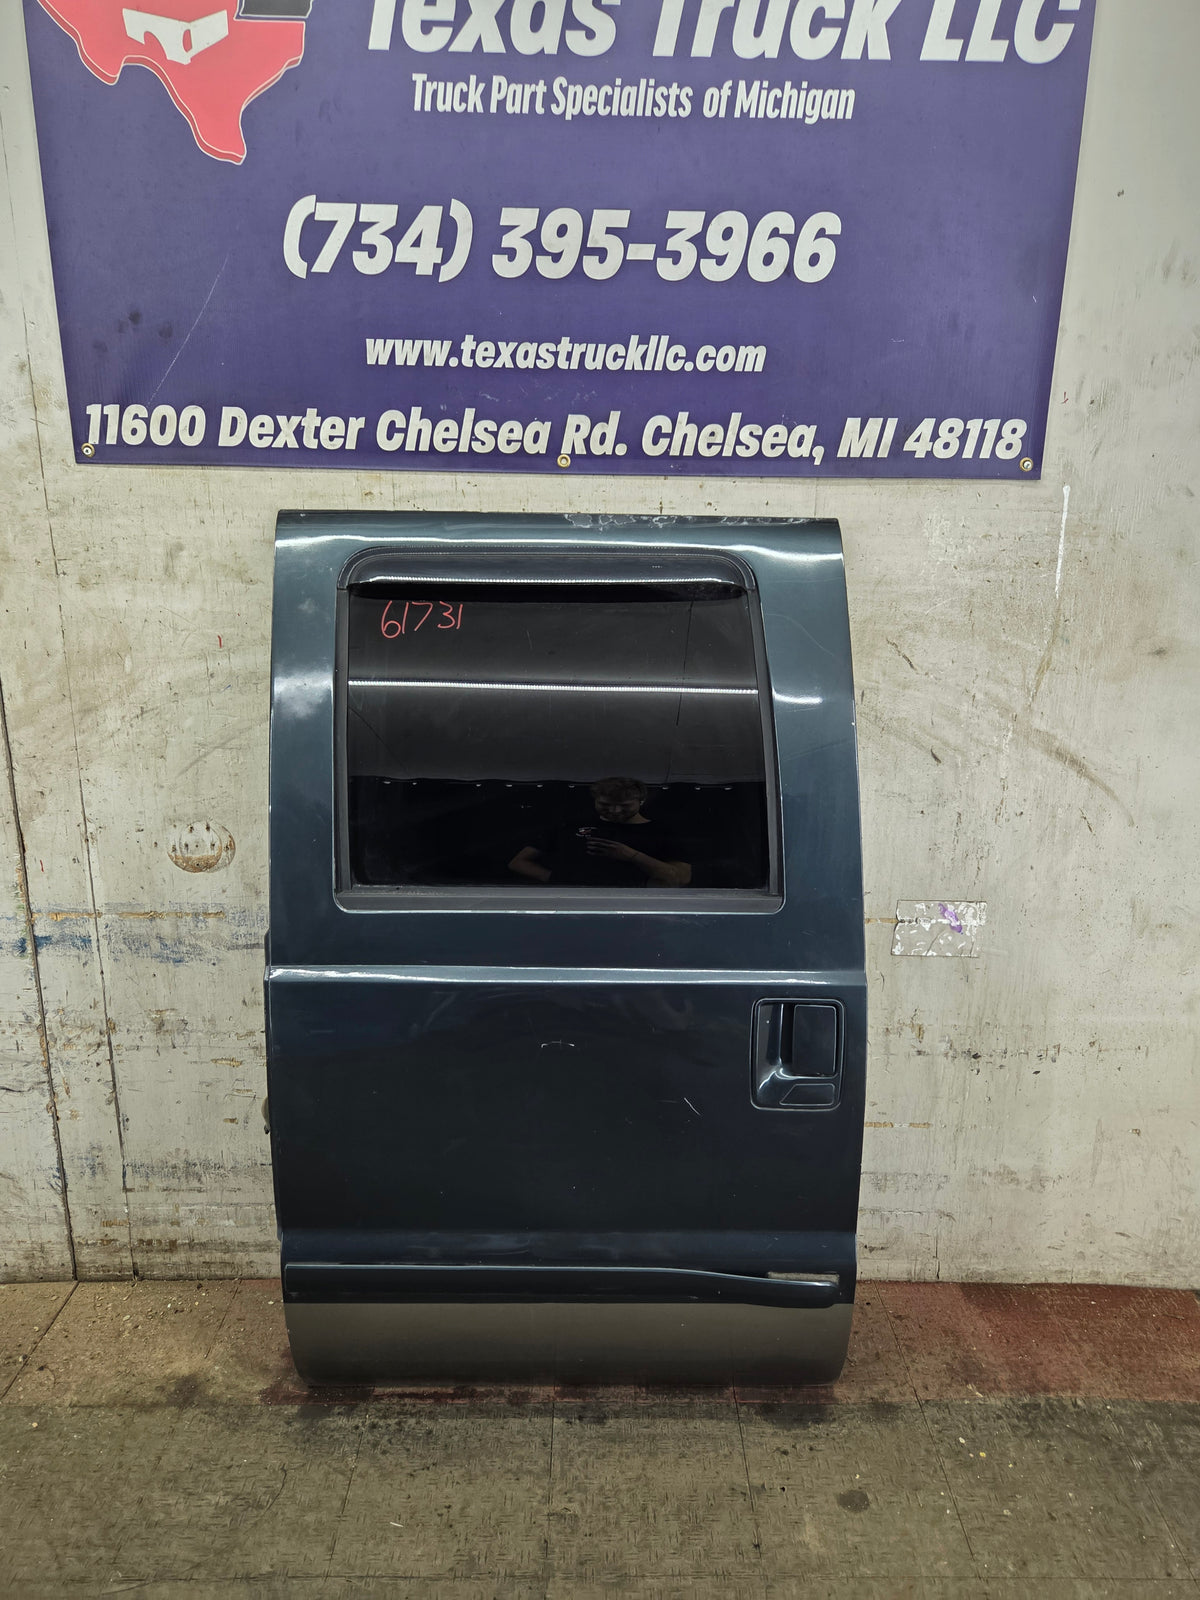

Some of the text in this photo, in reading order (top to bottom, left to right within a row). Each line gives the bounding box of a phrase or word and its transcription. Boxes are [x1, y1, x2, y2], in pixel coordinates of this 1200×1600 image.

[919, 0, 1082, 64] LLC
[412, 73, 856, 125] Truck Part Specialists of Michigan
[283, 194, 842, 284] (734) 395-3966
[365, 334, 767, 373] www.texastruckllc.com
[86, 403, 1028, 466] 11600 Dexter Chelsea Rd. Chelsea, MI 48118
[381, 600, 464, 639] 61731
